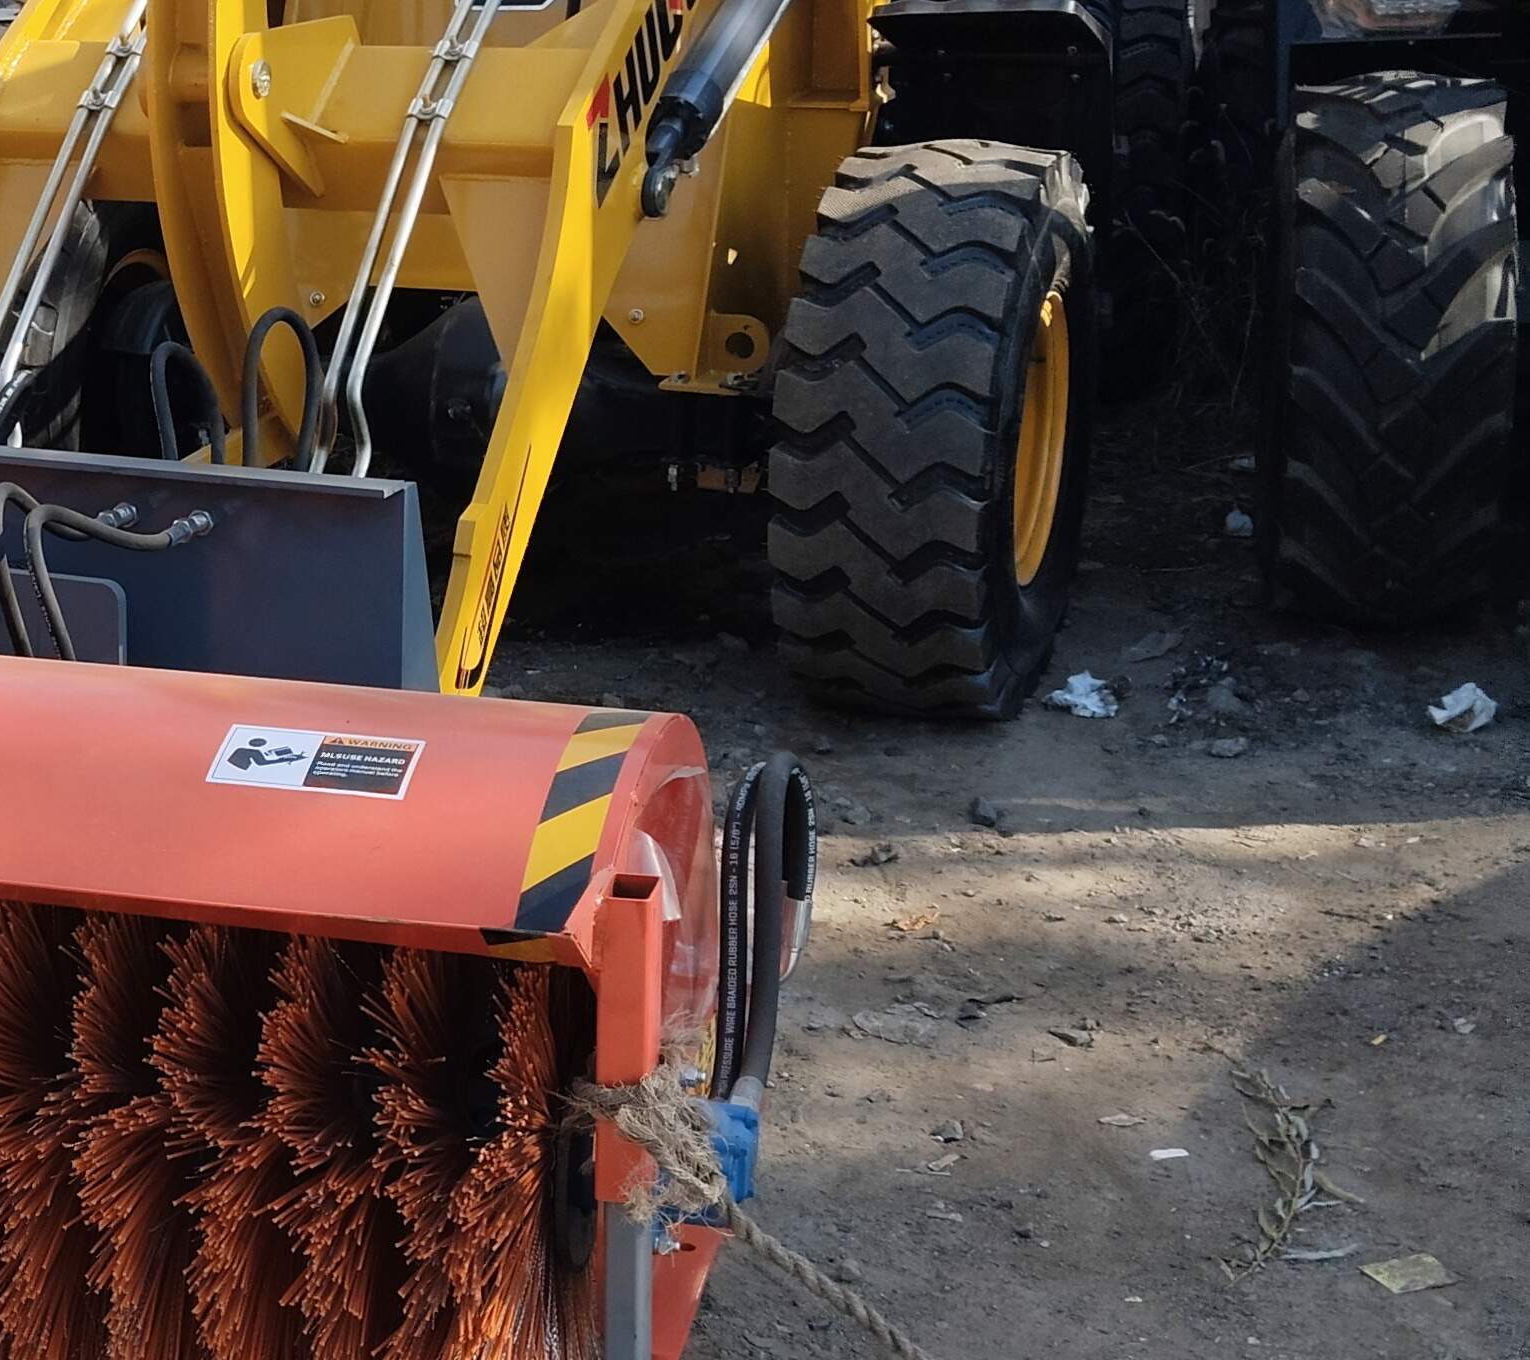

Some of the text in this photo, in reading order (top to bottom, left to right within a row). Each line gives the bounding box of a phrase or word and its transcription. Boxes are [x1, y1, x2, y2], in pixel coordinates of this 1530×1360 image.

[348, 739, 412, 750] WARNING
[364, 755, 406, 765] HAZARD
[728, 900, 739, 926] HOSE
[728, 927, 739, 967] RUBBER
[726, 968, 738, 1010] BRAIDED
[725, 1009, 737, 1034] WIRE
